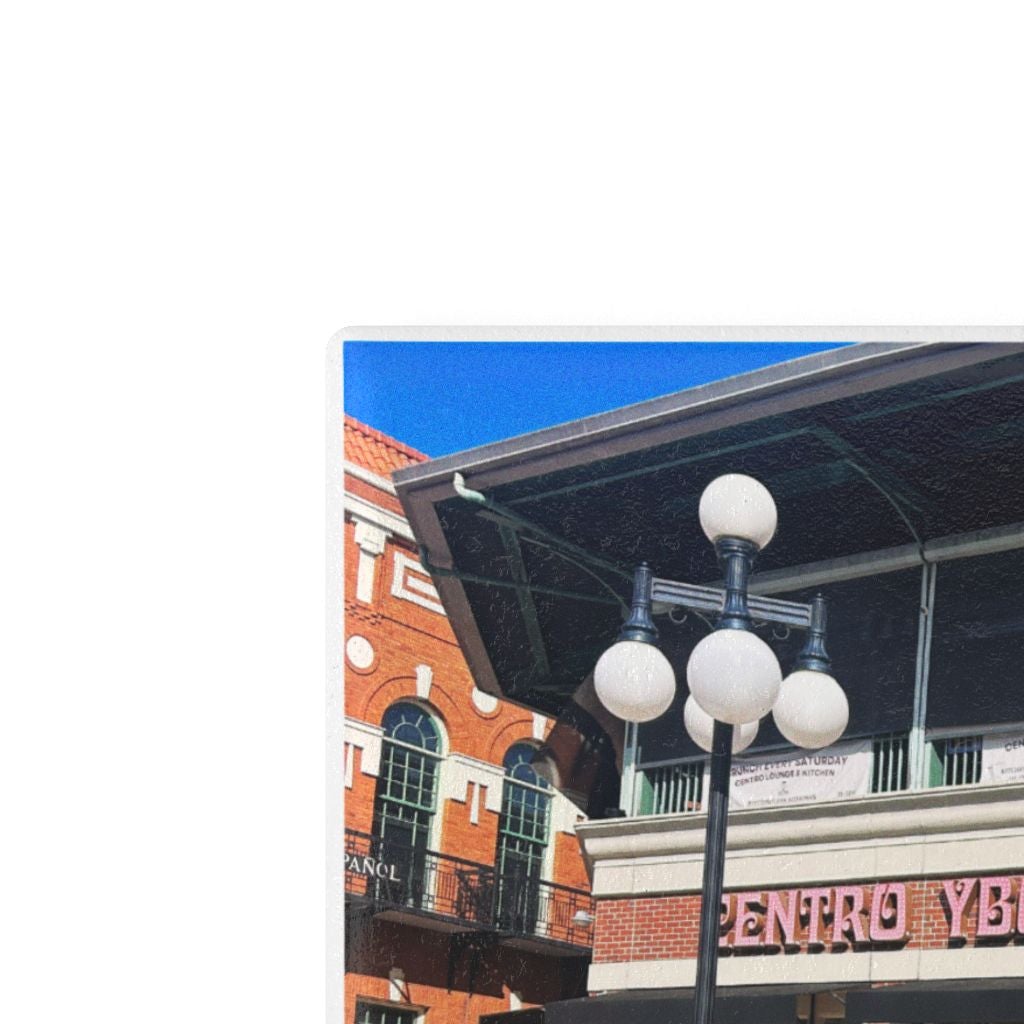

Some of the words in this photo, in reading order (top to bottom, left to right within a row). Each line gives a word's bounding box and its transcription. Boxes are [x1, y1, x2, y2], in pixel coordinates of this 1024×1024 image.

[730, 762, 762, 777] RUNCH
[794, 755, 848, 768] SATURDAY
[734, 774, 765, 787] CENTRO
[766, 769, 795, 781] LOUNGE
[801, 768, 836, 777] KITCHEN
